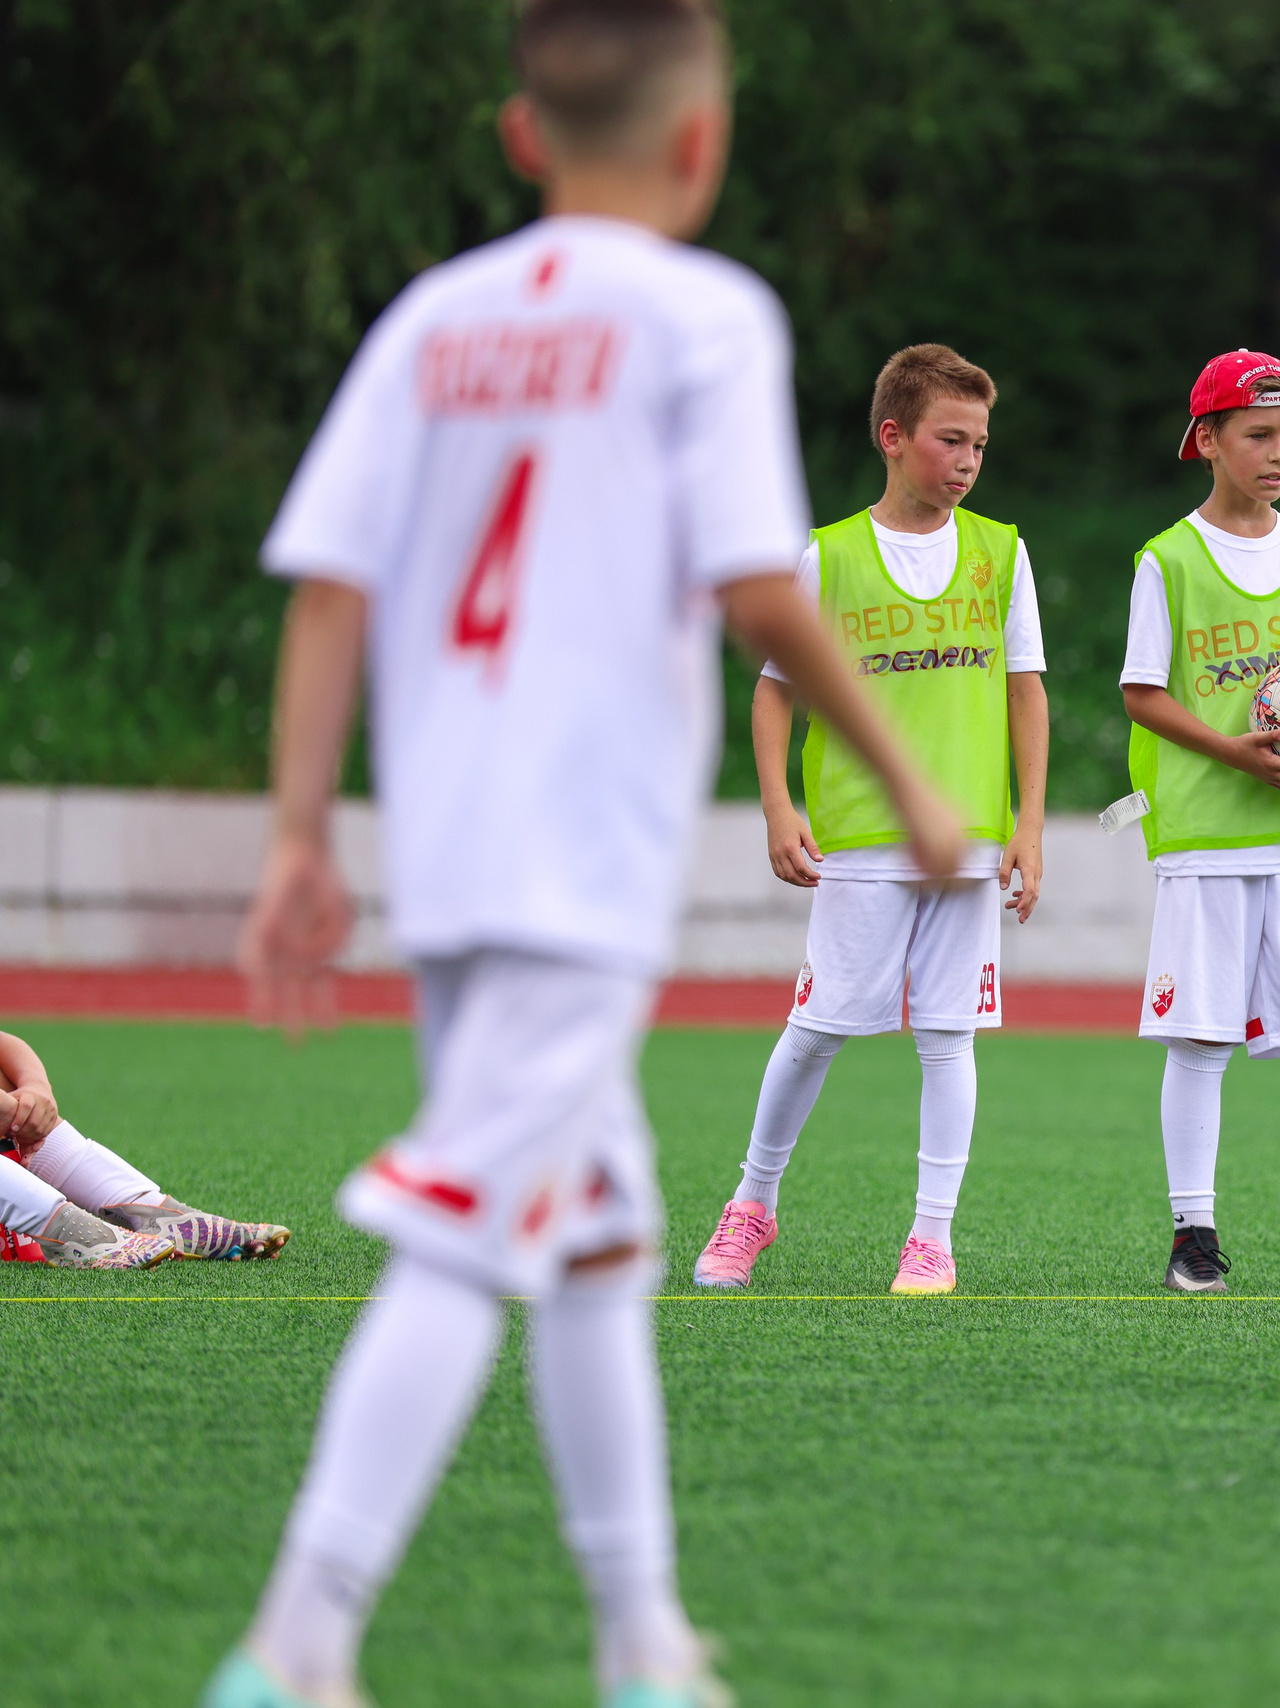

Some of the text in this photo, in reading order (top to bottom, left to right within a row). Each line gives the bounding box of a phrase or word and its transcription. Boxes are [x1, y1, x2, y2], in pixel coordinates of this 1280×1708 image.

[1236, 365, 1266, 388] FOREVER
[449, 446, 540, 692] 4
[841, 598, 998, 645] RED STAR
[1187, 620, 1260, 662] RED
[856, 647, 996, 676] DEMIX
[4, 1225, 19, 1260] SILAP
